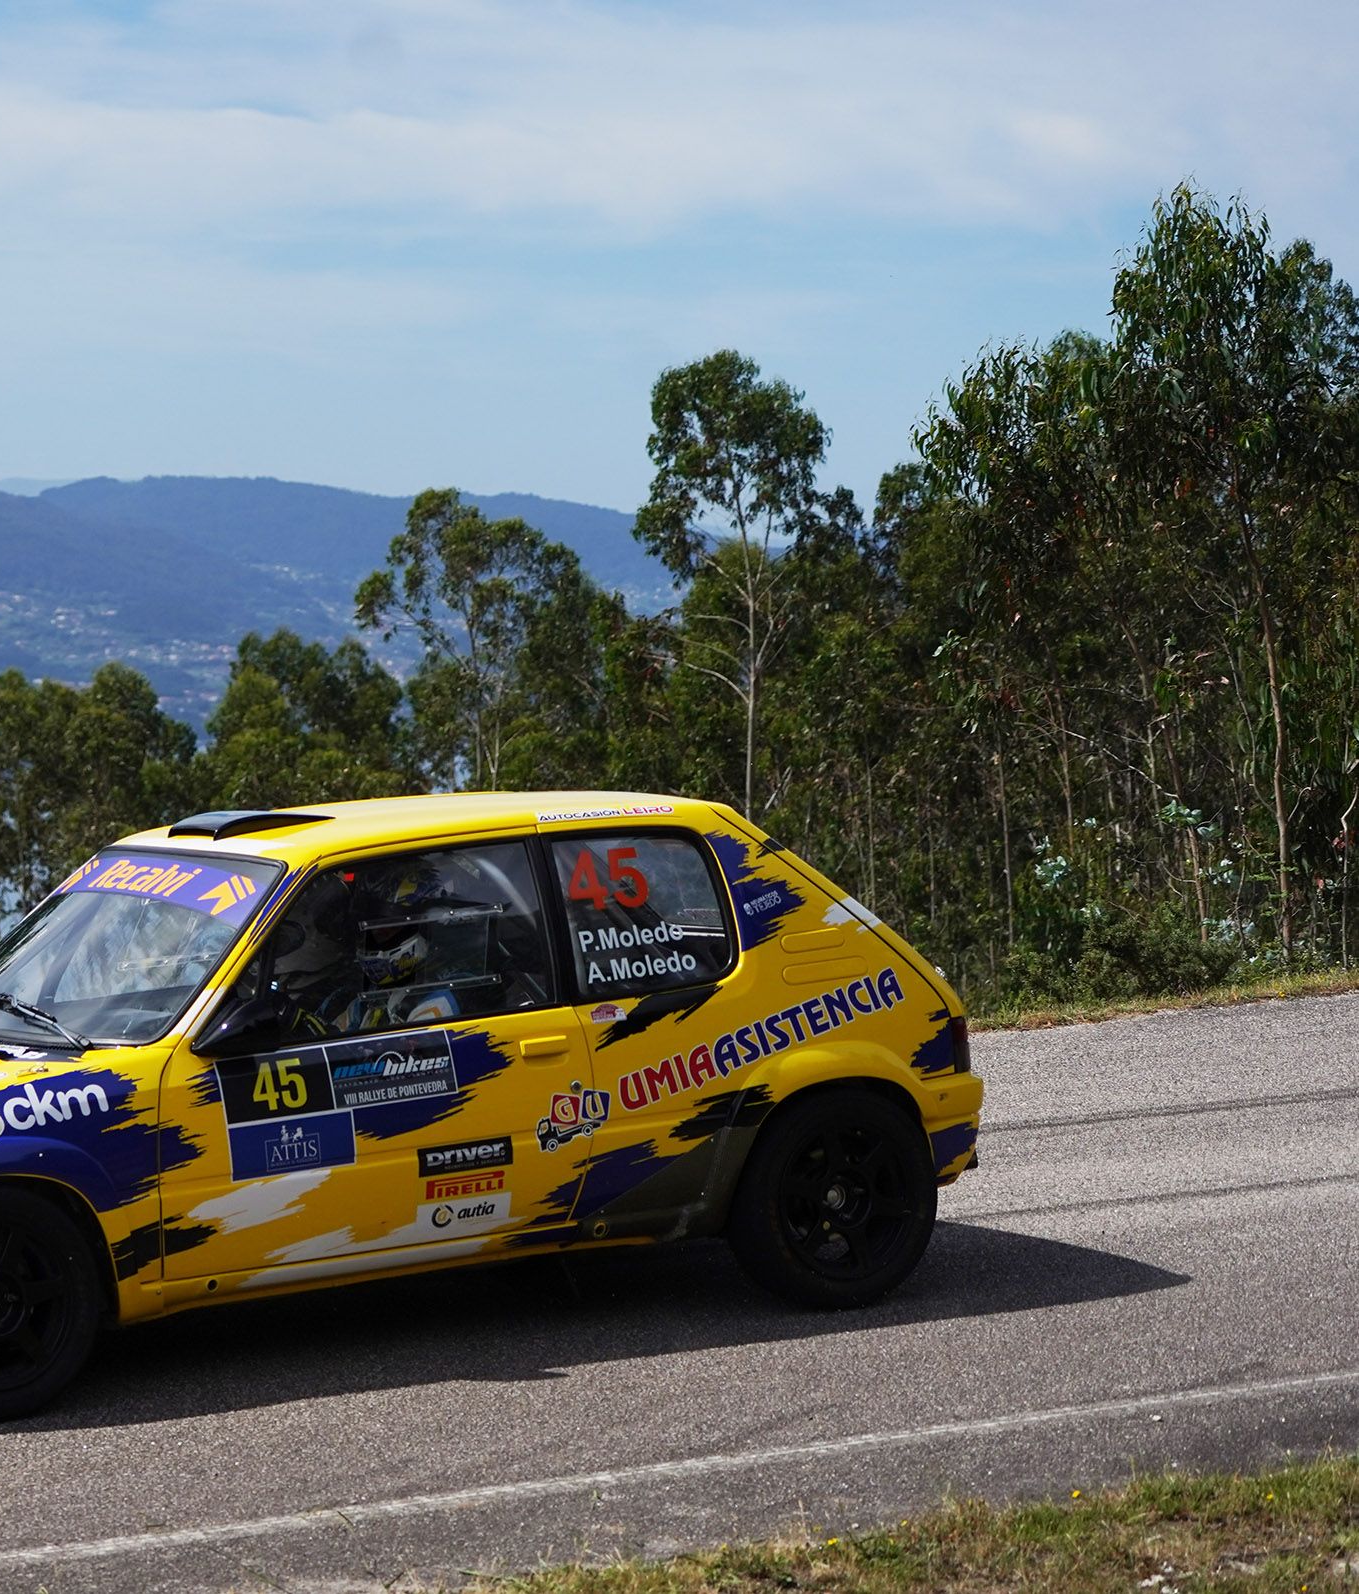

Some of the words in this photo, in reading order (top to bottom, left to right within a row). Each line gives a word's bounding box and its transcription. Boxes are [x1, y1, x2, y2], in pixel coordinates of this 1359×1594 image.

[622, 805, 673, 815] LEIRO
[89, 859, 203, 897] Recalvi
[568, 847, 649, 910] 45
[578, 921, 684, 953] P.Moledo
[587, 951, 697, 985] A.Moledo
[252, 1057, 308, 1111] 45
[343, 1092, 358, 1105] VIII
[358, 1089, 386, 1103] RALLYE
[387, 1087, 398, 1099] DE
[399, 1080, 448, 1097] PONTEVEDRA
[3, 1083, 110, 1131] ckm
[270, 1140, 318, 1163] ATTIS
[426, 1170, 505, 1200] PIRELLI
[457, 1201, 496, 1220] autia
